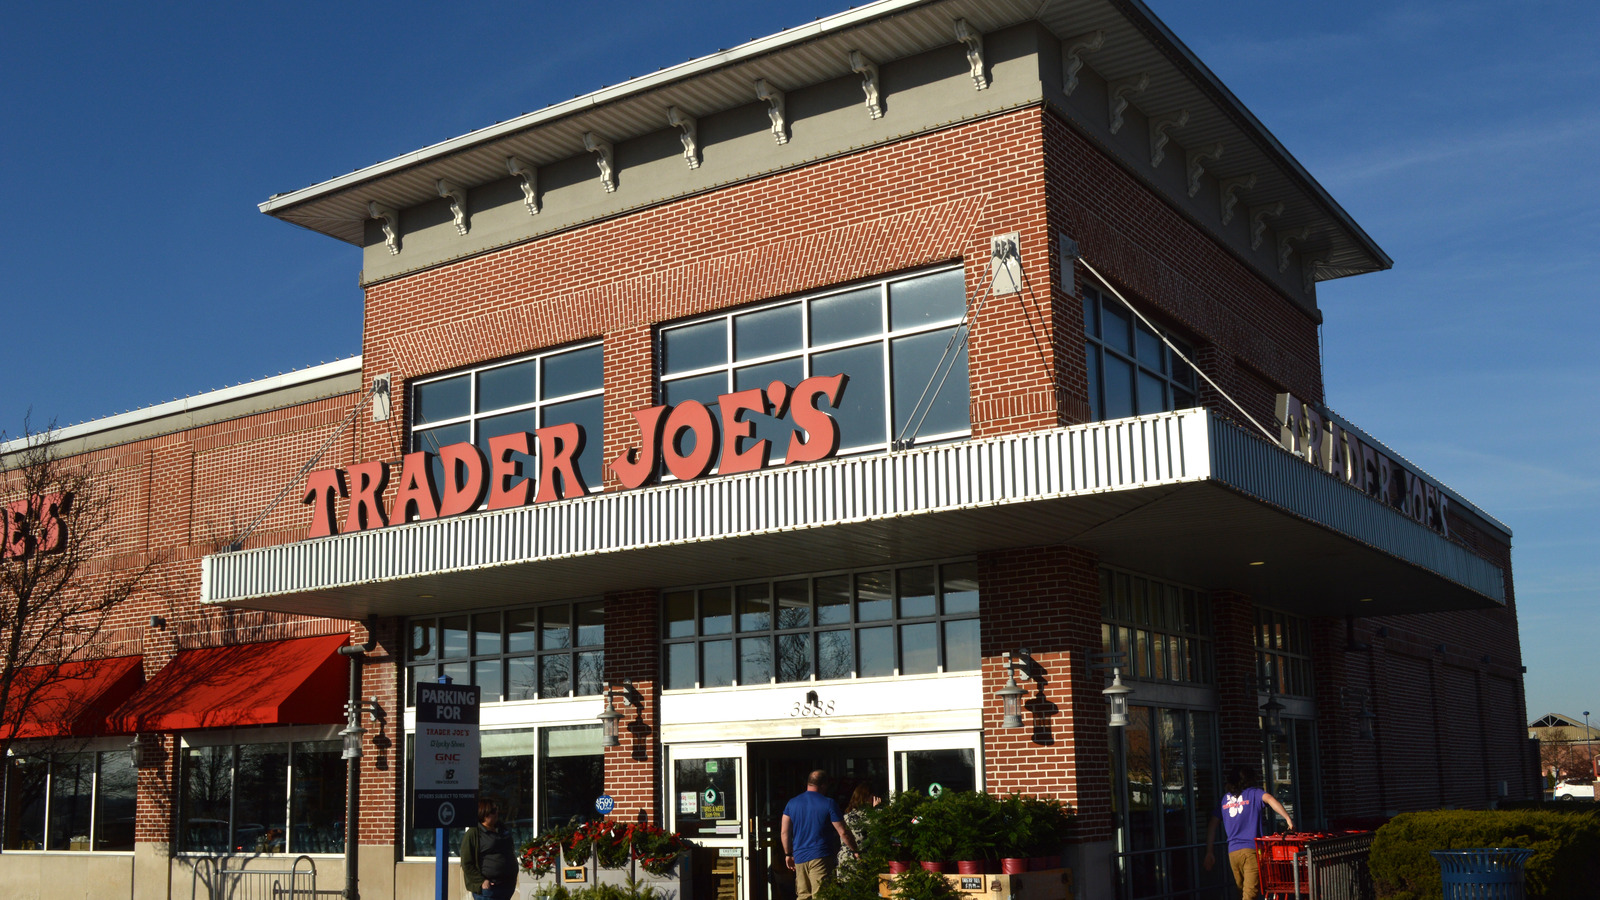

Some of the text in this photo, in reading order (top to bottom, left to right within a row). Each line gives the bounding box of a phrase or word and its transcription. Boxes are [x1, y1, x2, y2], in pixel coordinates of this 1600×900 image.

[303, 373, 849, 538] TRADER JOE'S
[1274, 393, 1391, 502] TRADER
[422, 689, 475, 706] PARKING
[436, 705, 461, 720] FOR
[790, 699, 835, 717] 3888
[426, 728, 470, 737] TRADER JOE'S
[435, 753, 461, 761] GNC
